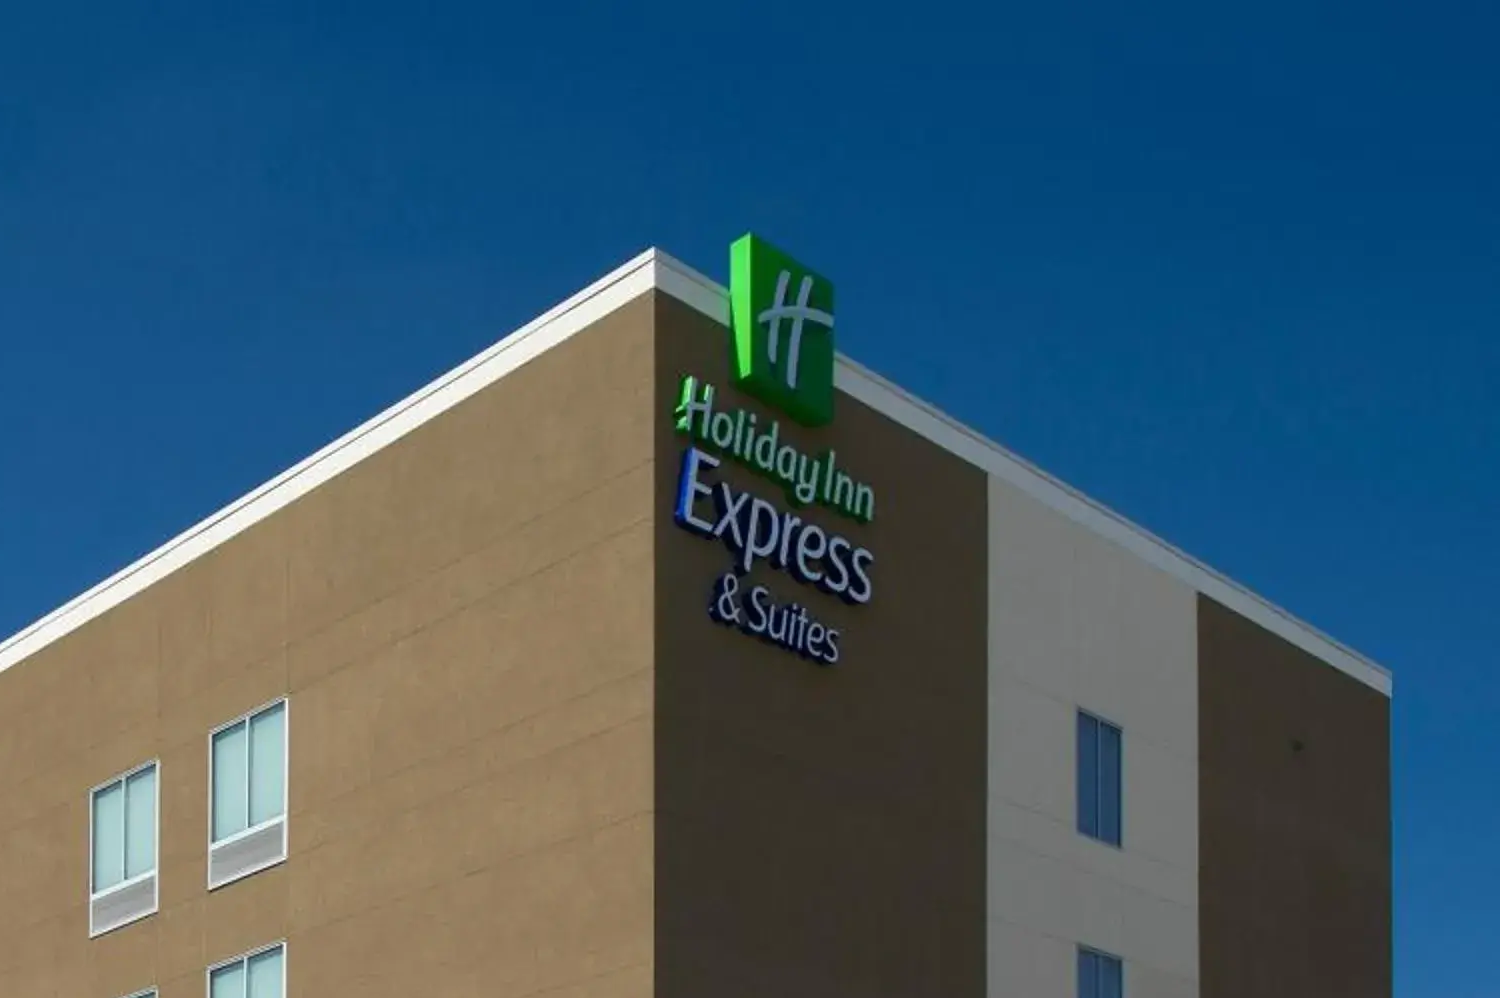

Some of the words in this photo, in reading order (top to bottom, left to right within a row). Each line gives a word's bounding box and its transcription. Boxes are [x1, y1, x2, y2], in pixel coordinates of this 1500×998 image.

[757, 269, 835, 389] H
[677, 375, 820, 503] Holiday
[823, 449, 874, 521] Inn
[680, 447, 874, 603] Express
[717, 573, 741, 624] &
[749, 586, 840, 663] Suites
